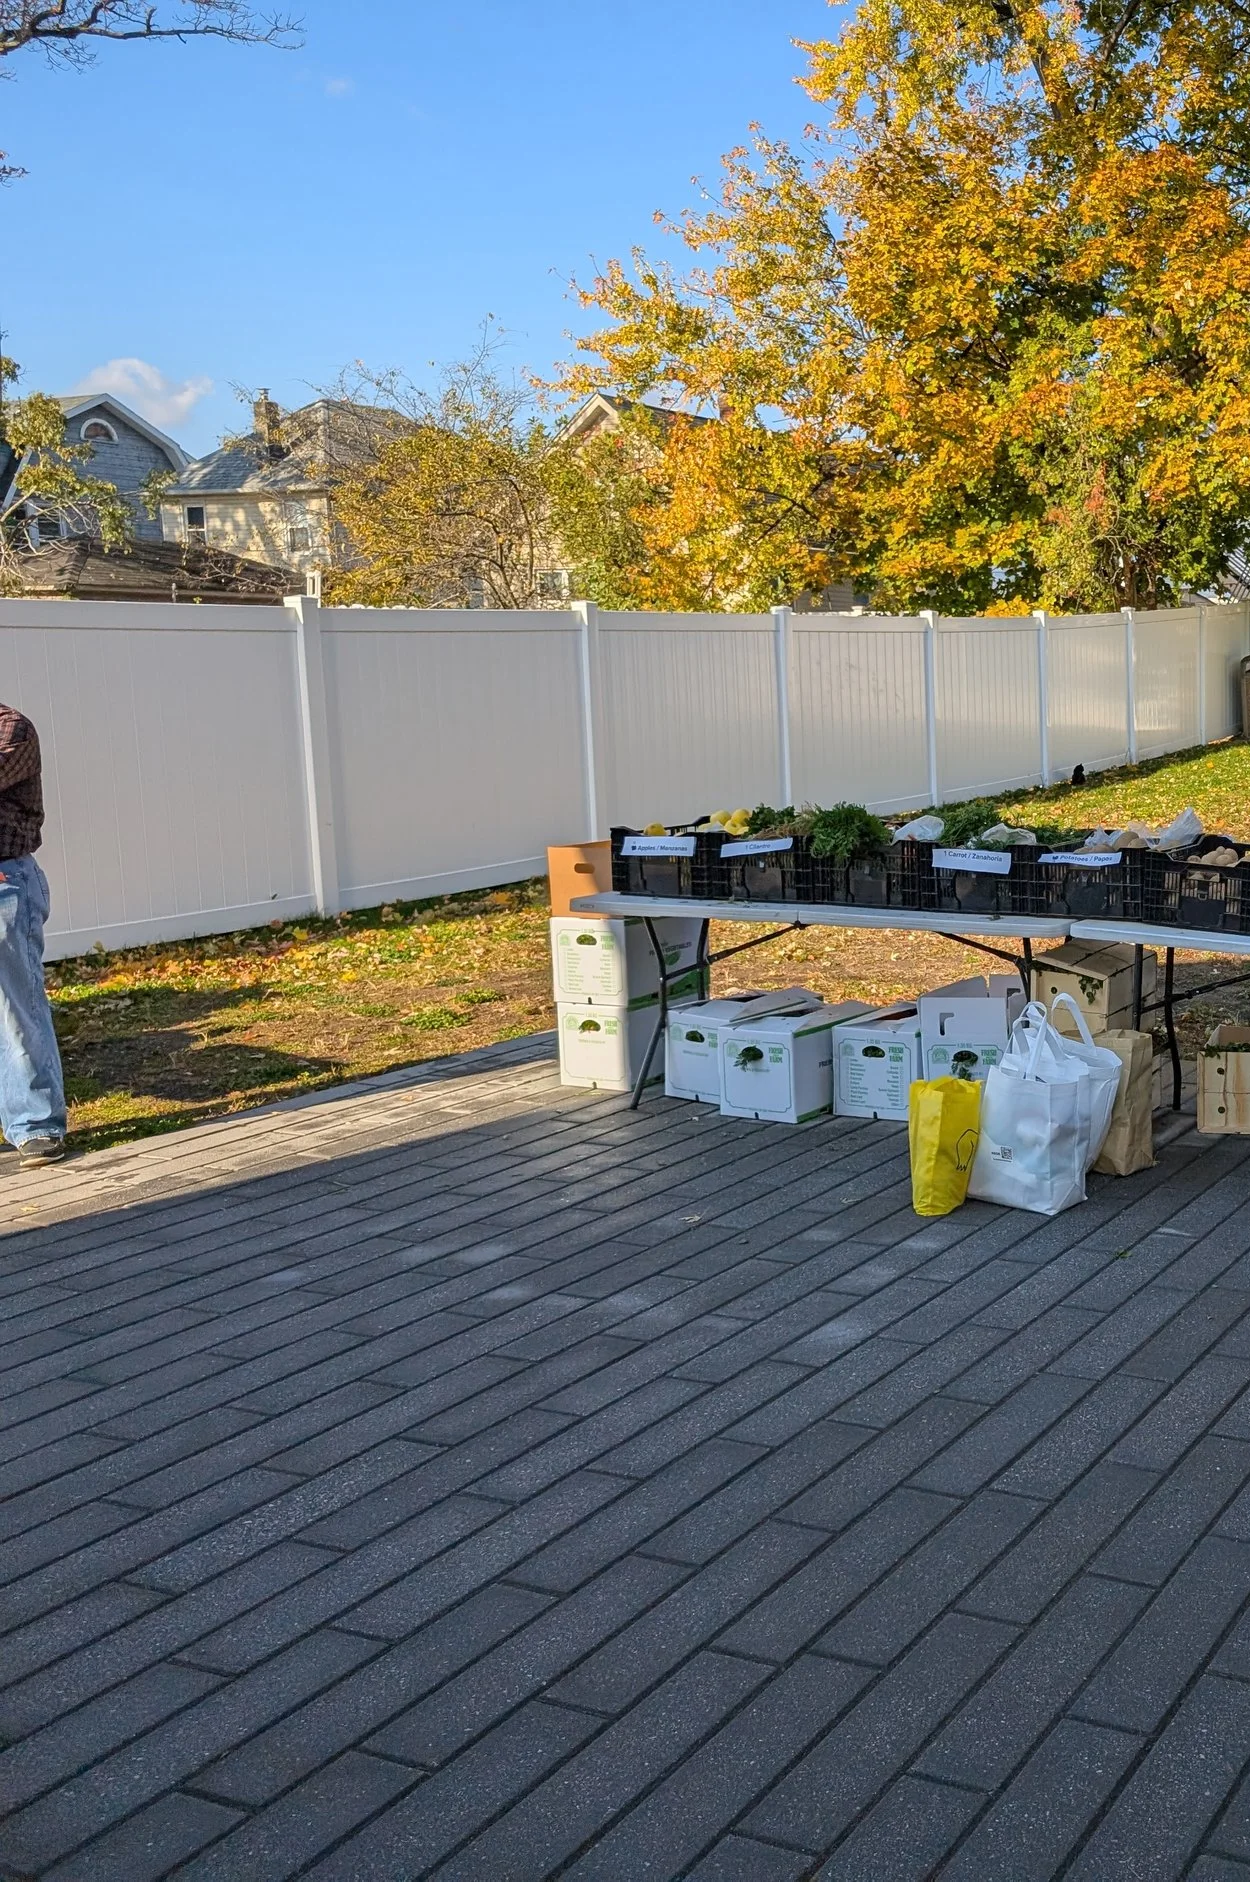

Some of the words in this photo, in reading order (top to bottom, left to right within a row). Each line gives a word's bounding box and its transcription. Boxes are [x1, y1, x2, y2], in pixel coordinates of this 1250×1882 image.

[749, 842, 771, 850] Cilantro
[972, 853, 1003, 862] Zanahoria
[1060, 854, 1089, 862] Potatoes
[1094, 855, 1113, 863] Papas
